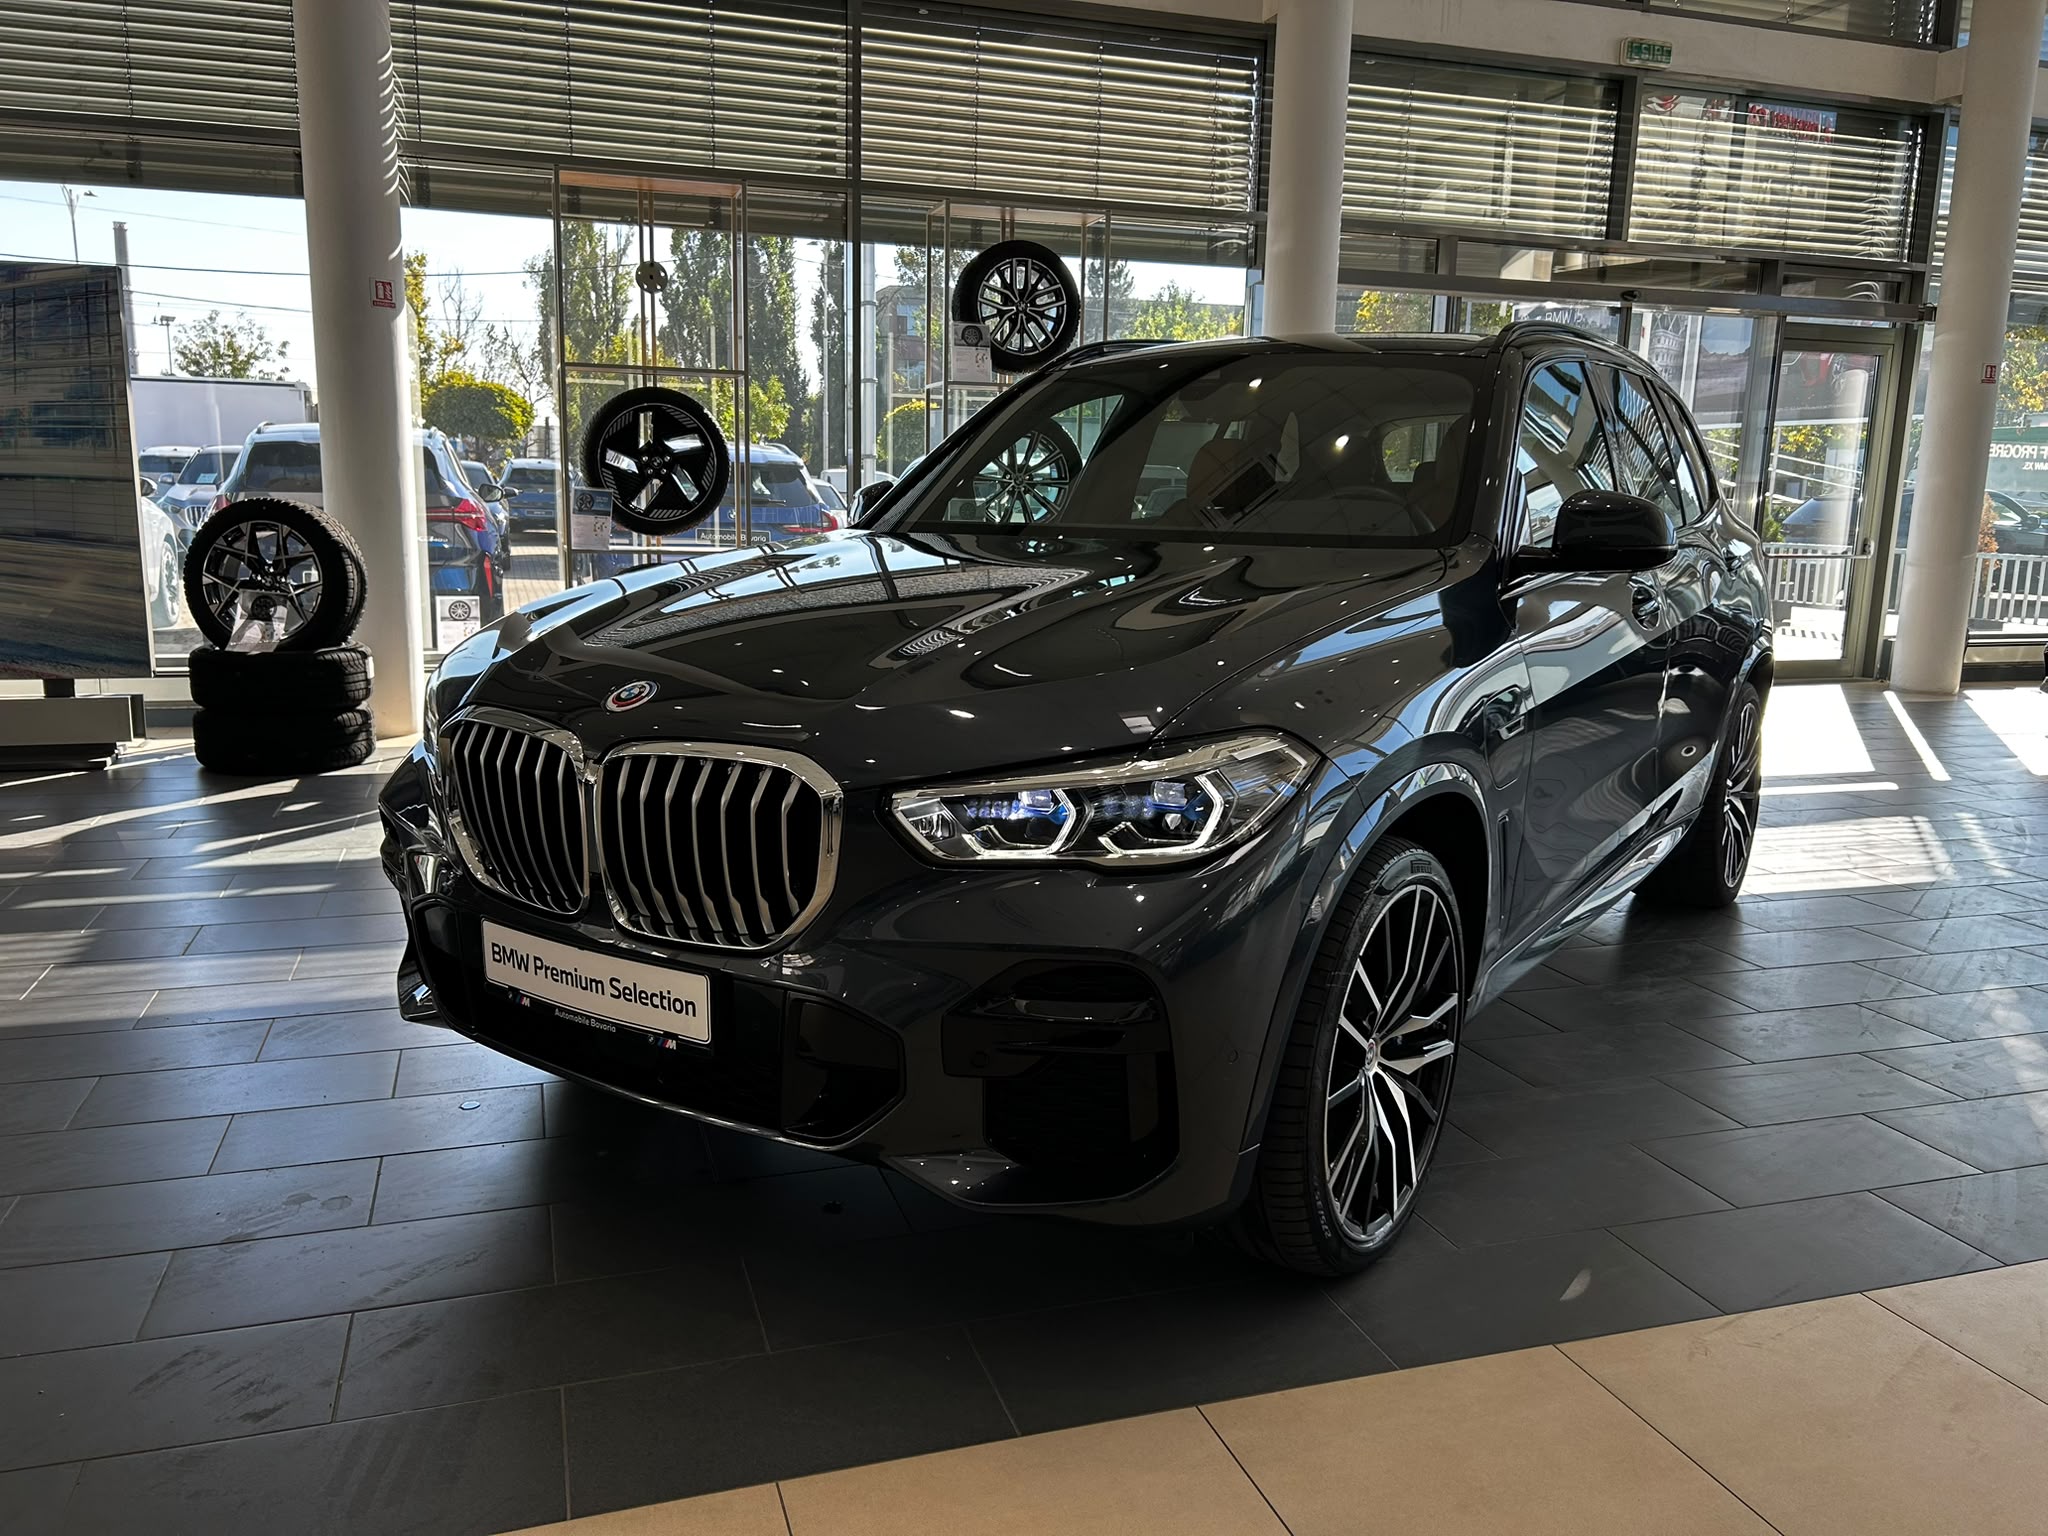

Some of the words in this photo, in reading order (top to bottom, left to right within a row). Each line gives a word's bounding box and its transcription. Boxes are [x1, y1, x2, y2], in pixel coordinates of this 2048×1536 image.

[740, 533, 767, 542] Bvaria
[1410, 860, 1432, 874] PIRELLI
[491, 941, 530, 973] BMW
[533, 955, 605, 996] Premium
[609, 976, 697, 1018] Selection
[554, 1007, 590, 1026] Automobile
[590, 1018, 616, 1033] Bavaria
